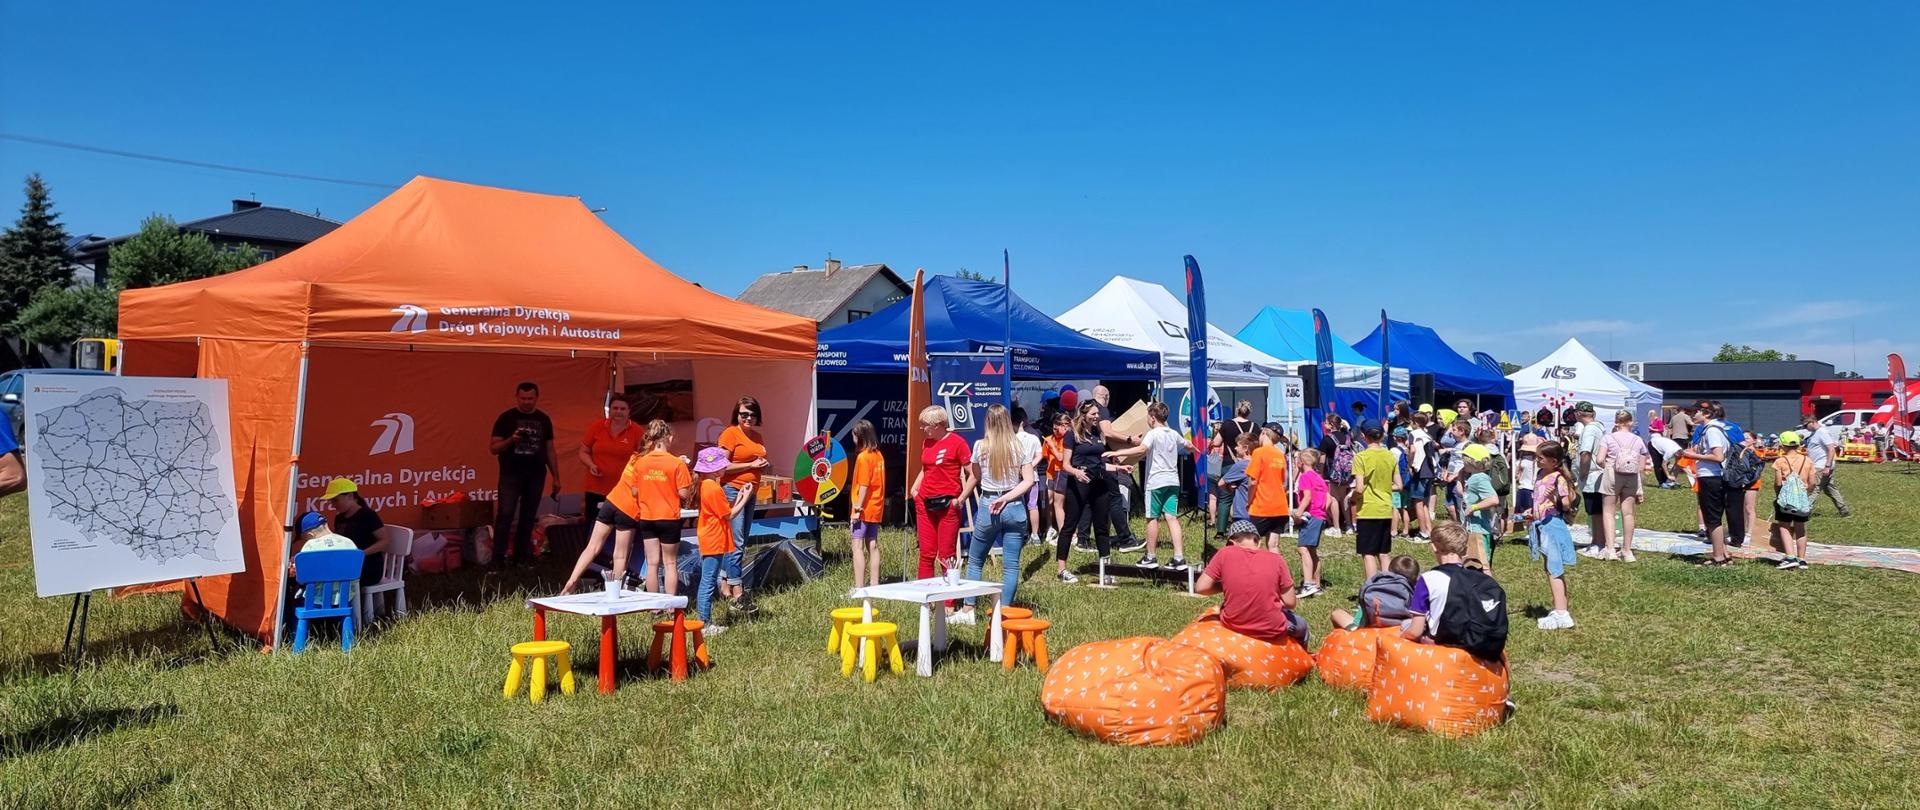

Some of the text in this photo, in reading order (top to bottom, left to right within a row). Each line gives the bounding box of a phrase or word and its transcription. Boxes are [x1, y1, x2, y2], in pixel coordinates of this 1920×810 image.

[439, 305, 571, 322] Generalna Dyrekcja
[439, 320, 621, 340] Dróg Krajowych i Autostrad
[815, 359, 847, 367] LEJOWEGO
[816, 351, 847, 359] ANSPORTU
[400, 466, 476, 486] Dyrekcja
[413, 490, 419, 506] i
